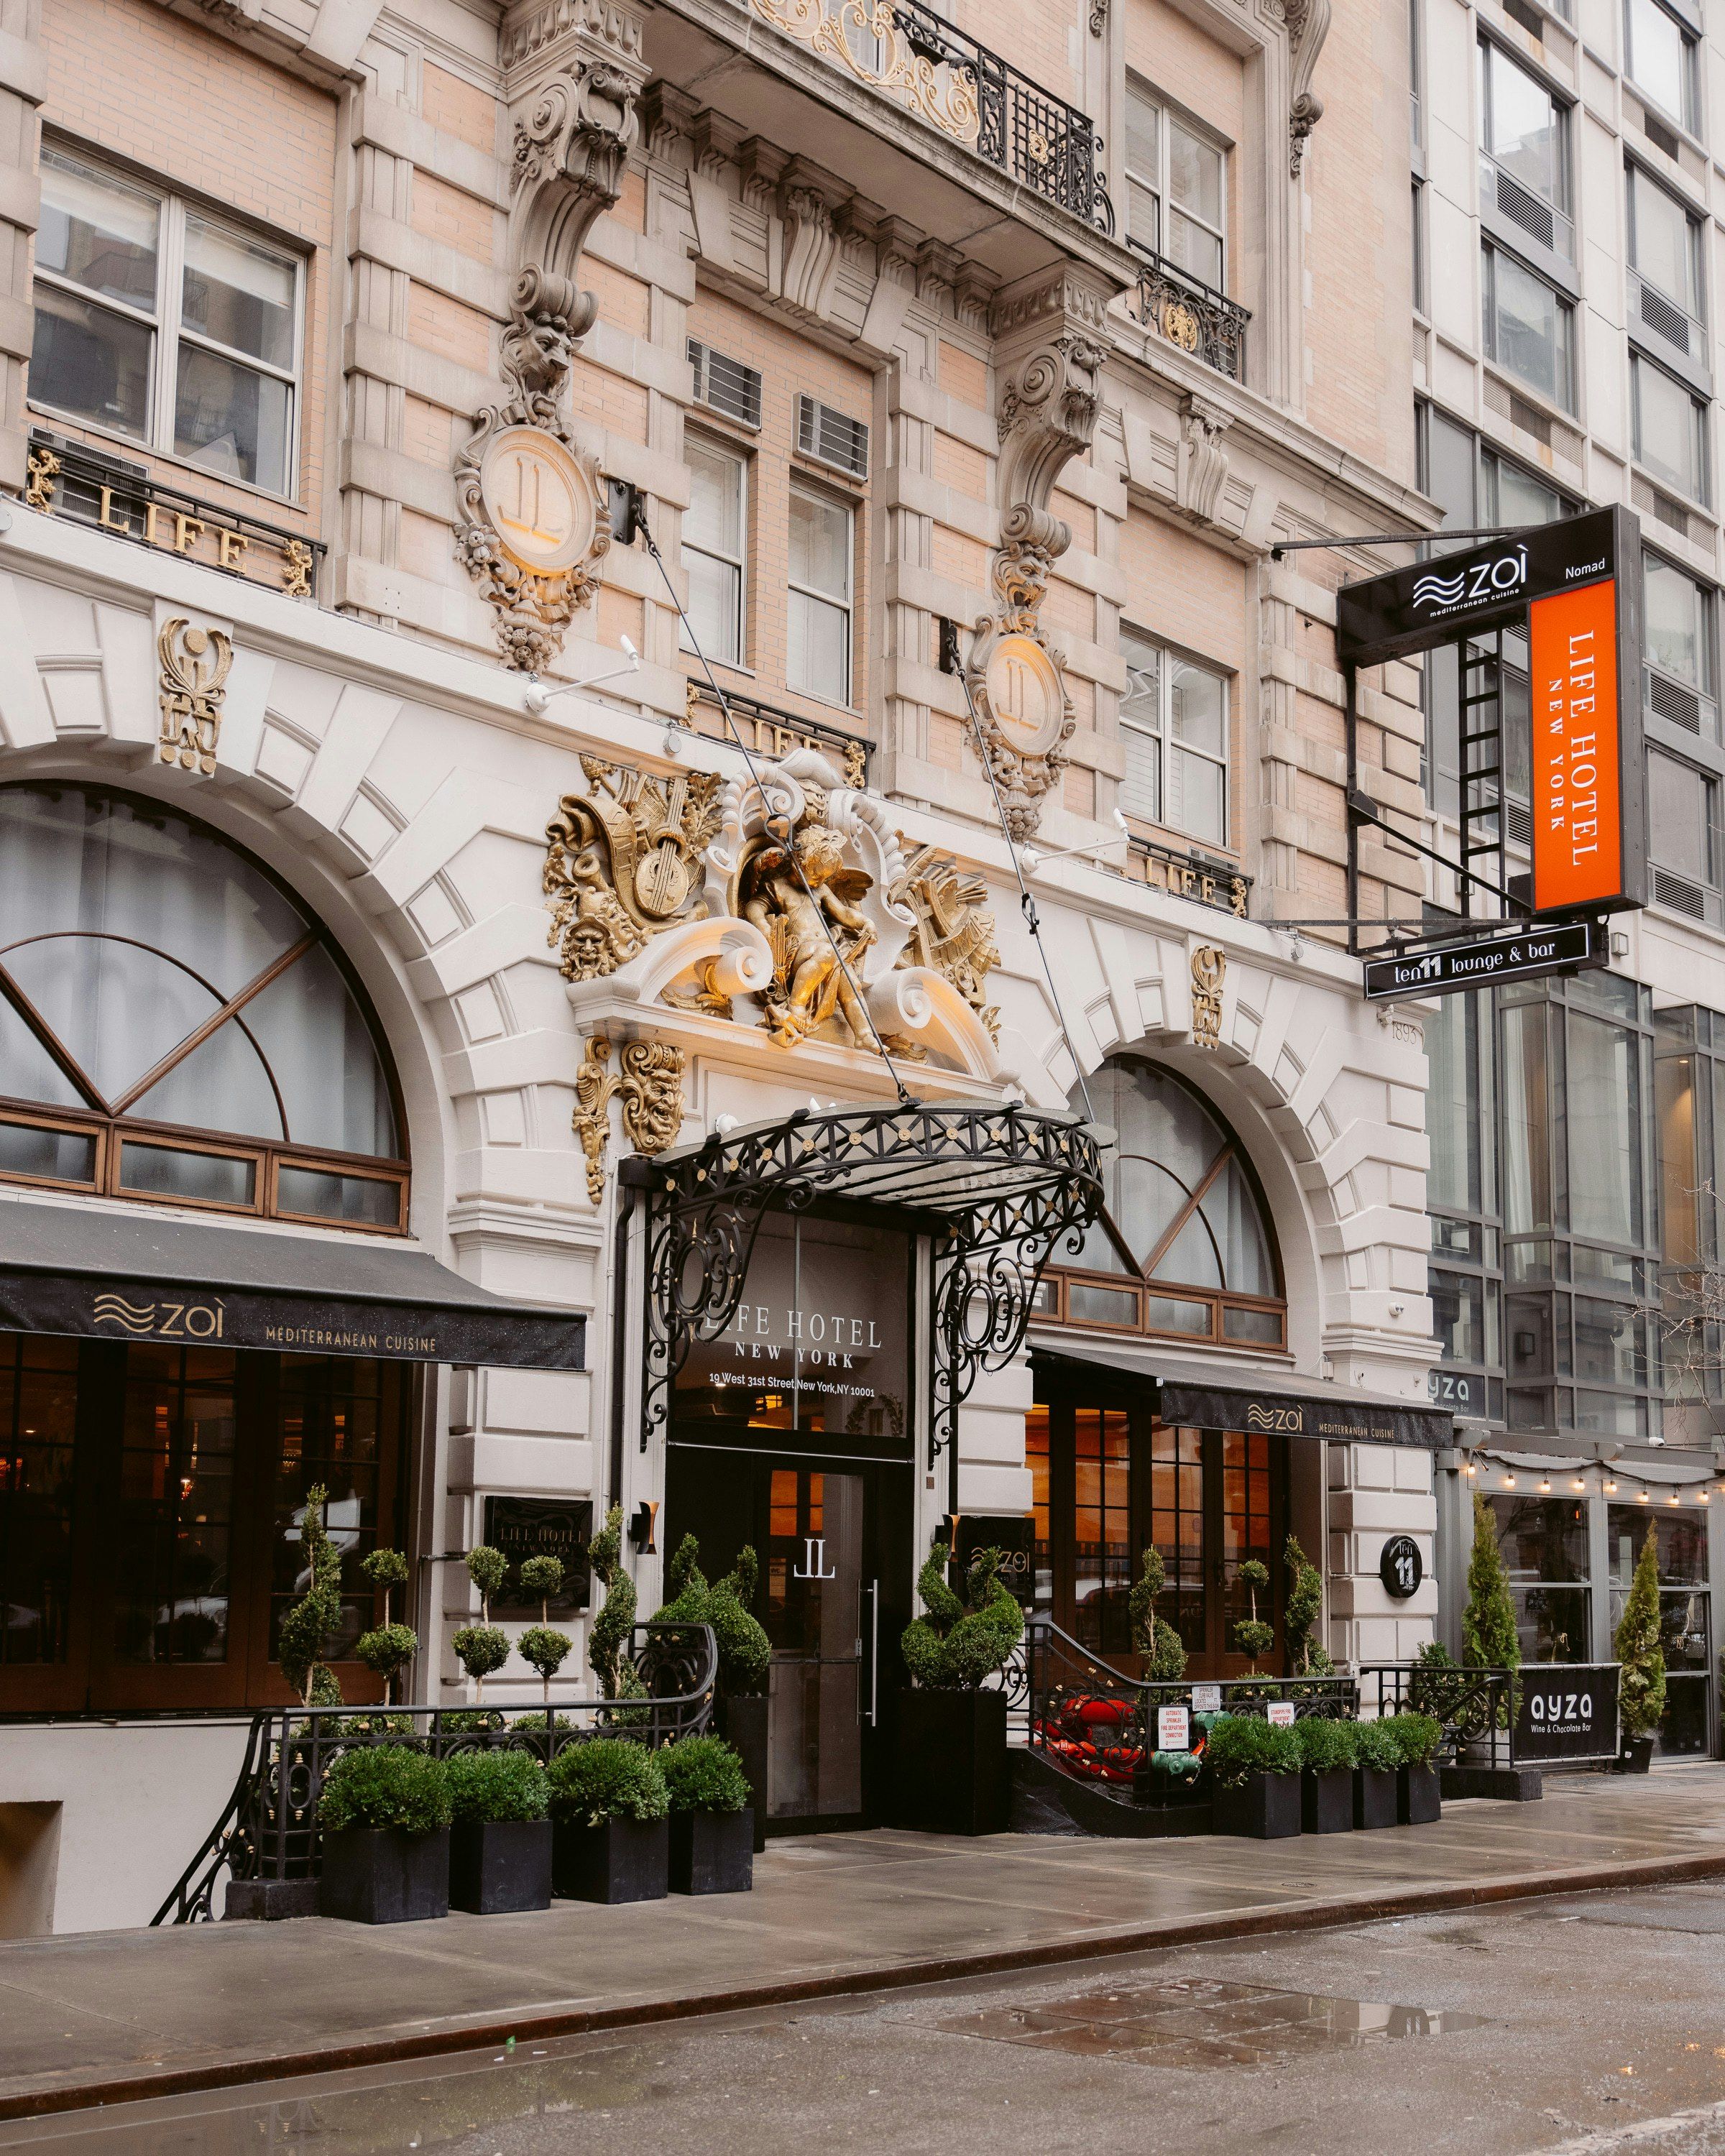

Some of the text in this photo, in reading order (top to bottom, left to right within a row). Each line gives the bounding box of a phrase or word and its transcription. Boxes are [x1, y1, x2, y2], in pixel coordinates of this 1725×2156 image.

[97, 485, 249, 574] LIFE
[1565, 558, 1605, 579] Nomad
[1430, 588, 1519, 617] mediterranean cuisine
[1549, 678, 1565, 831] NEW YORK
[1569, 630, 1598, 866] LIFE HOTEL
[1146, 856, 1216, 905] LIFE
[1451, 953, 1503, 973] lounge
[1509, 946, 1522, 962] &
[1528, 943, 1555, 958] bar
[266, 1327, 436, 1353] MEDITERRANEAN CUISINE
[786, 1310, 882, 1348] HOTEL
[735, 1341, 852, 1368] NEW YORK
[709, 1373, 719, 1384] 19
[722, 1372, 745, 1385] West
[748, 1376, 765, 1387] 31st
[850, 1387, 875, 1397] 10001
[1319, 1423, 1394, 1439] MEDITERRANEAN CUISINE
[1394, 1556, 1413, 1585] 11
[1531, 1694, 1592, 1721] ayza
[1552, 1724, 1581, 1733] Chocolate
[1582, 1723, 1591, 1731] Bar
